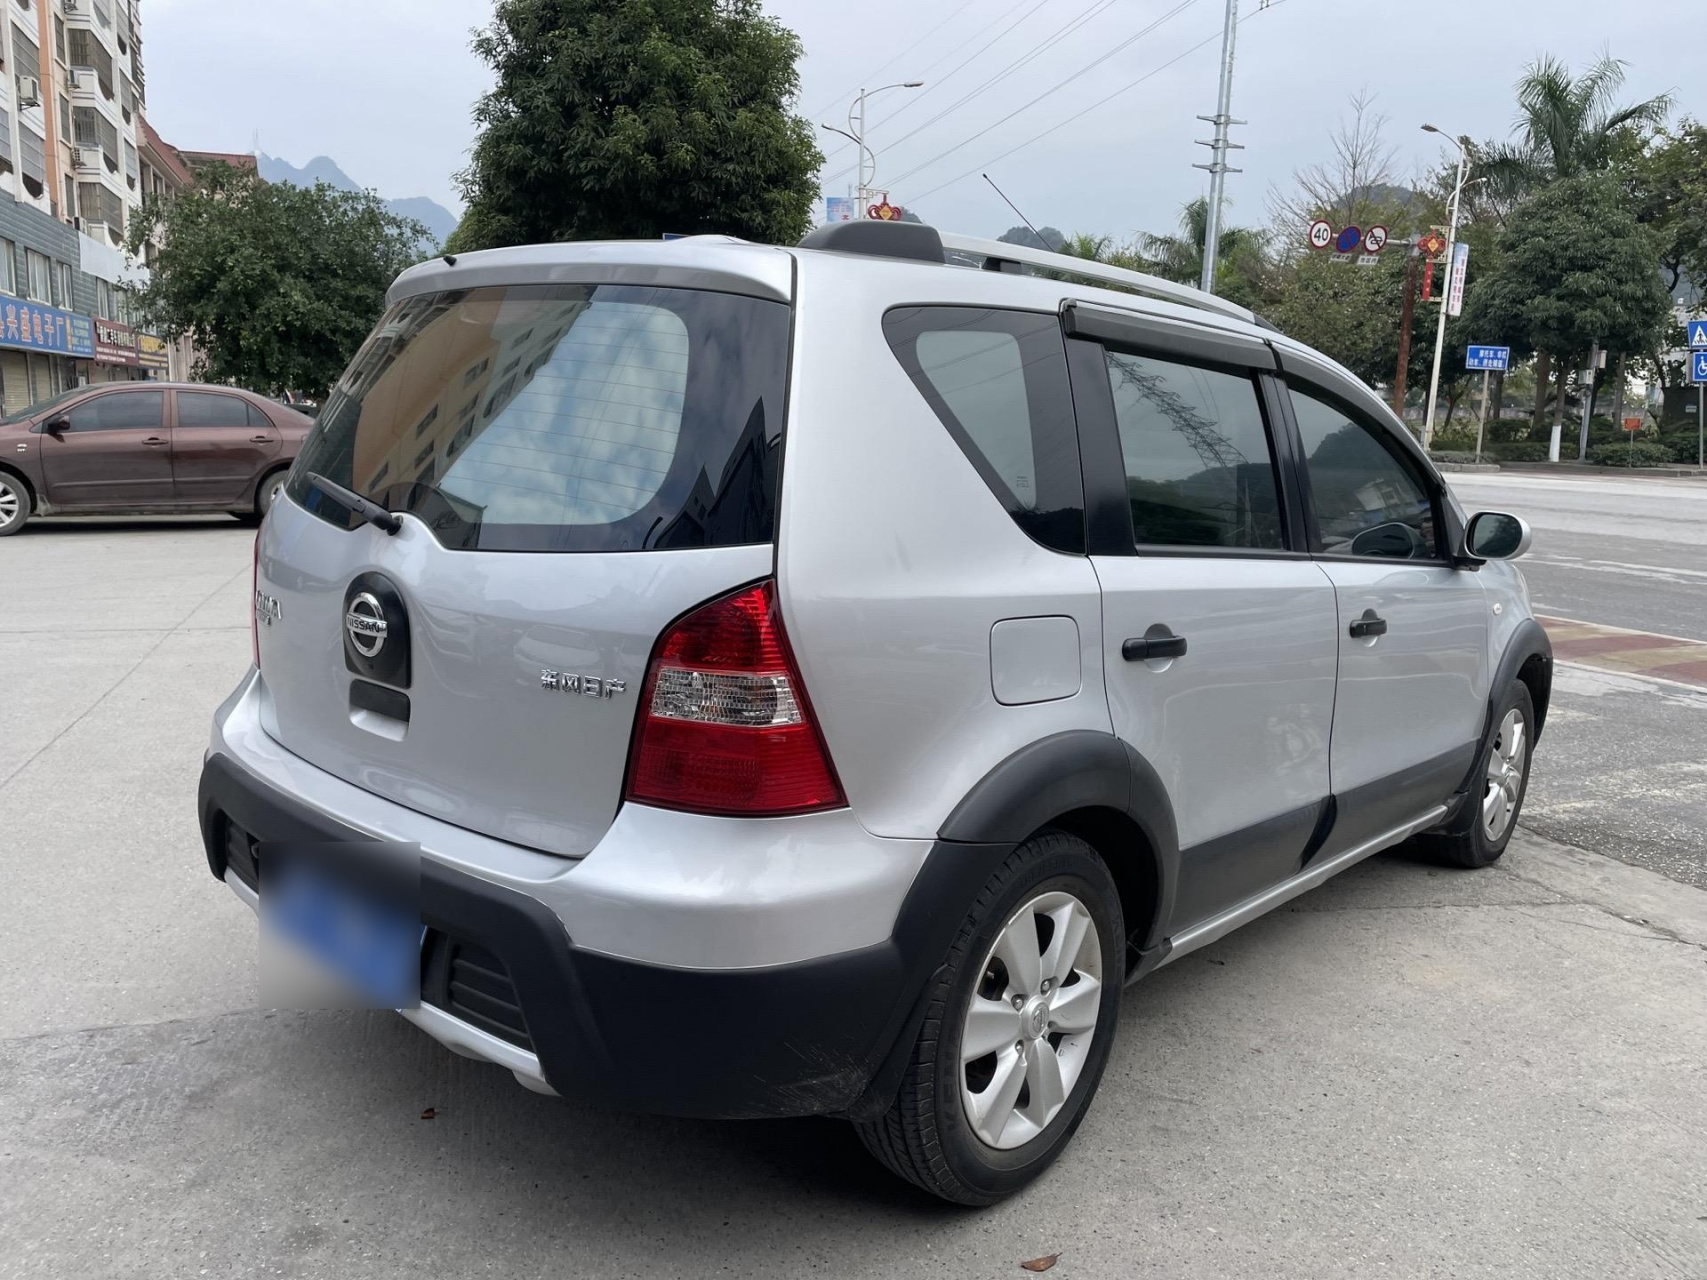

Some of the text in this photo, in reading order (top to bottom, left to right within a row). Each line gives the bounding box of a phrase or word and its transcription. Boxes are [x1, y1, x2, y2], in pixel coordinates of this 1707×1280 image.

[1313, 227, 1329, 242] 40
[347, 616, 380, 633] NISSAN
[540, 668, 627, 699] 东风日产
